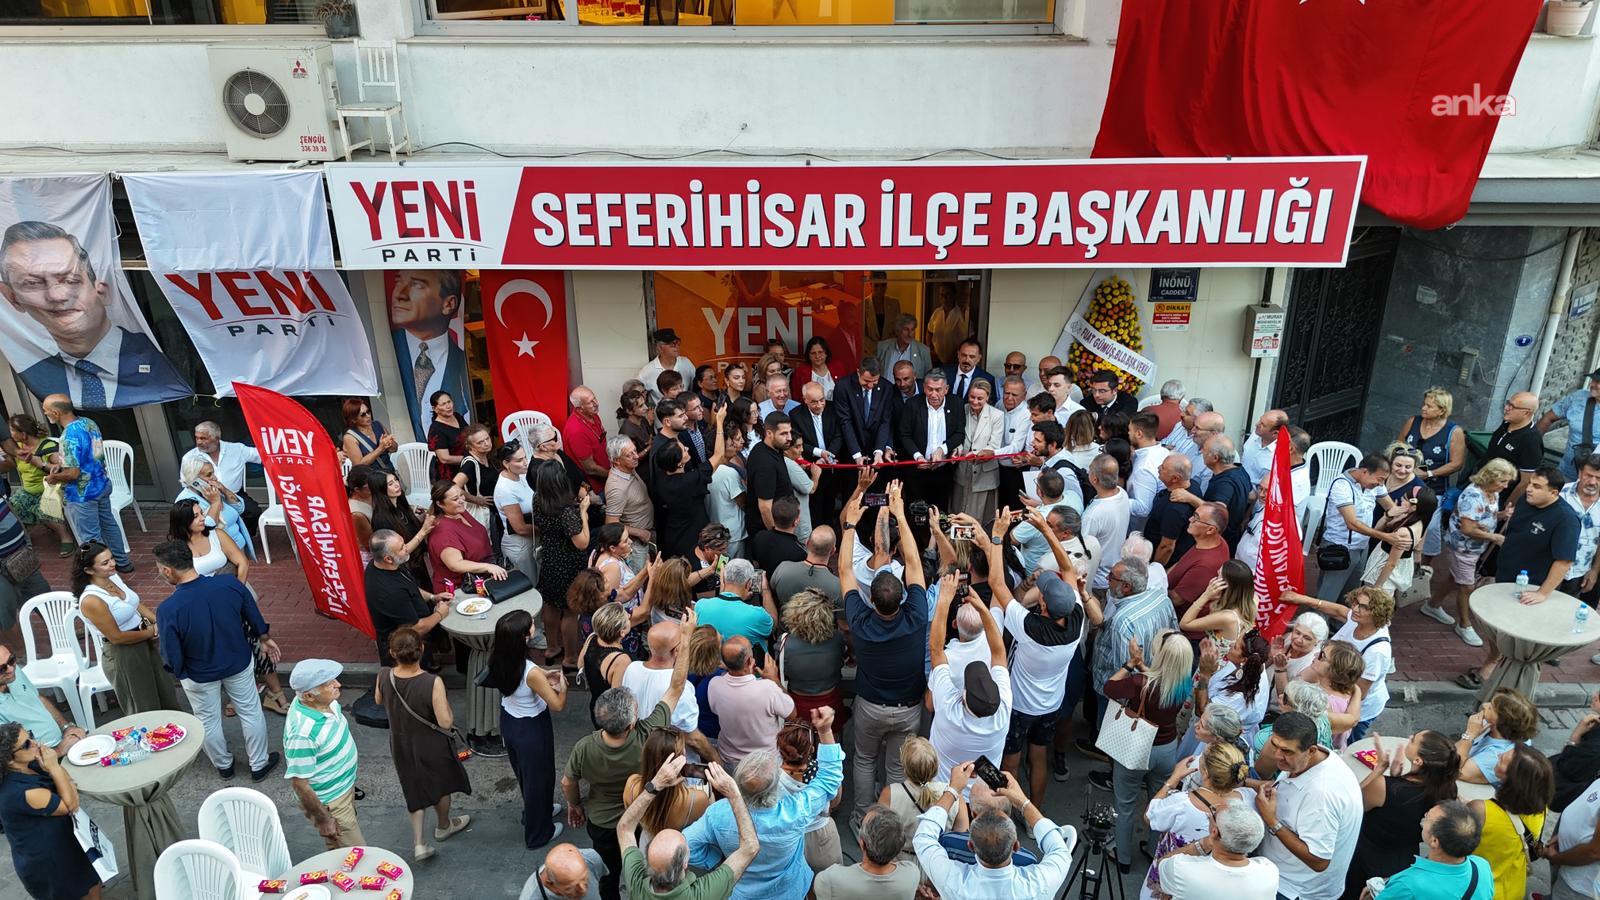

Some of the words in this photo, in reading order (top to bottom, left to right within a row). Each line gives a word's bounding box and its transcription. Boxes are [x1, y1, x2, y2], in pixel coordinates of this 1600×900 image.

[531, 179, 867, 248] SEFERİHİSAR
[880, 178, 993, 260] İLÇE
[1003, 176, 1334, 259] BAŞKANLIĞI
[1159, 275, 1191, 288] İNÖNÜ
[1160, 288, 1188, 296] CADDESİ
[1080, 327, 1096, 344] FUAT
